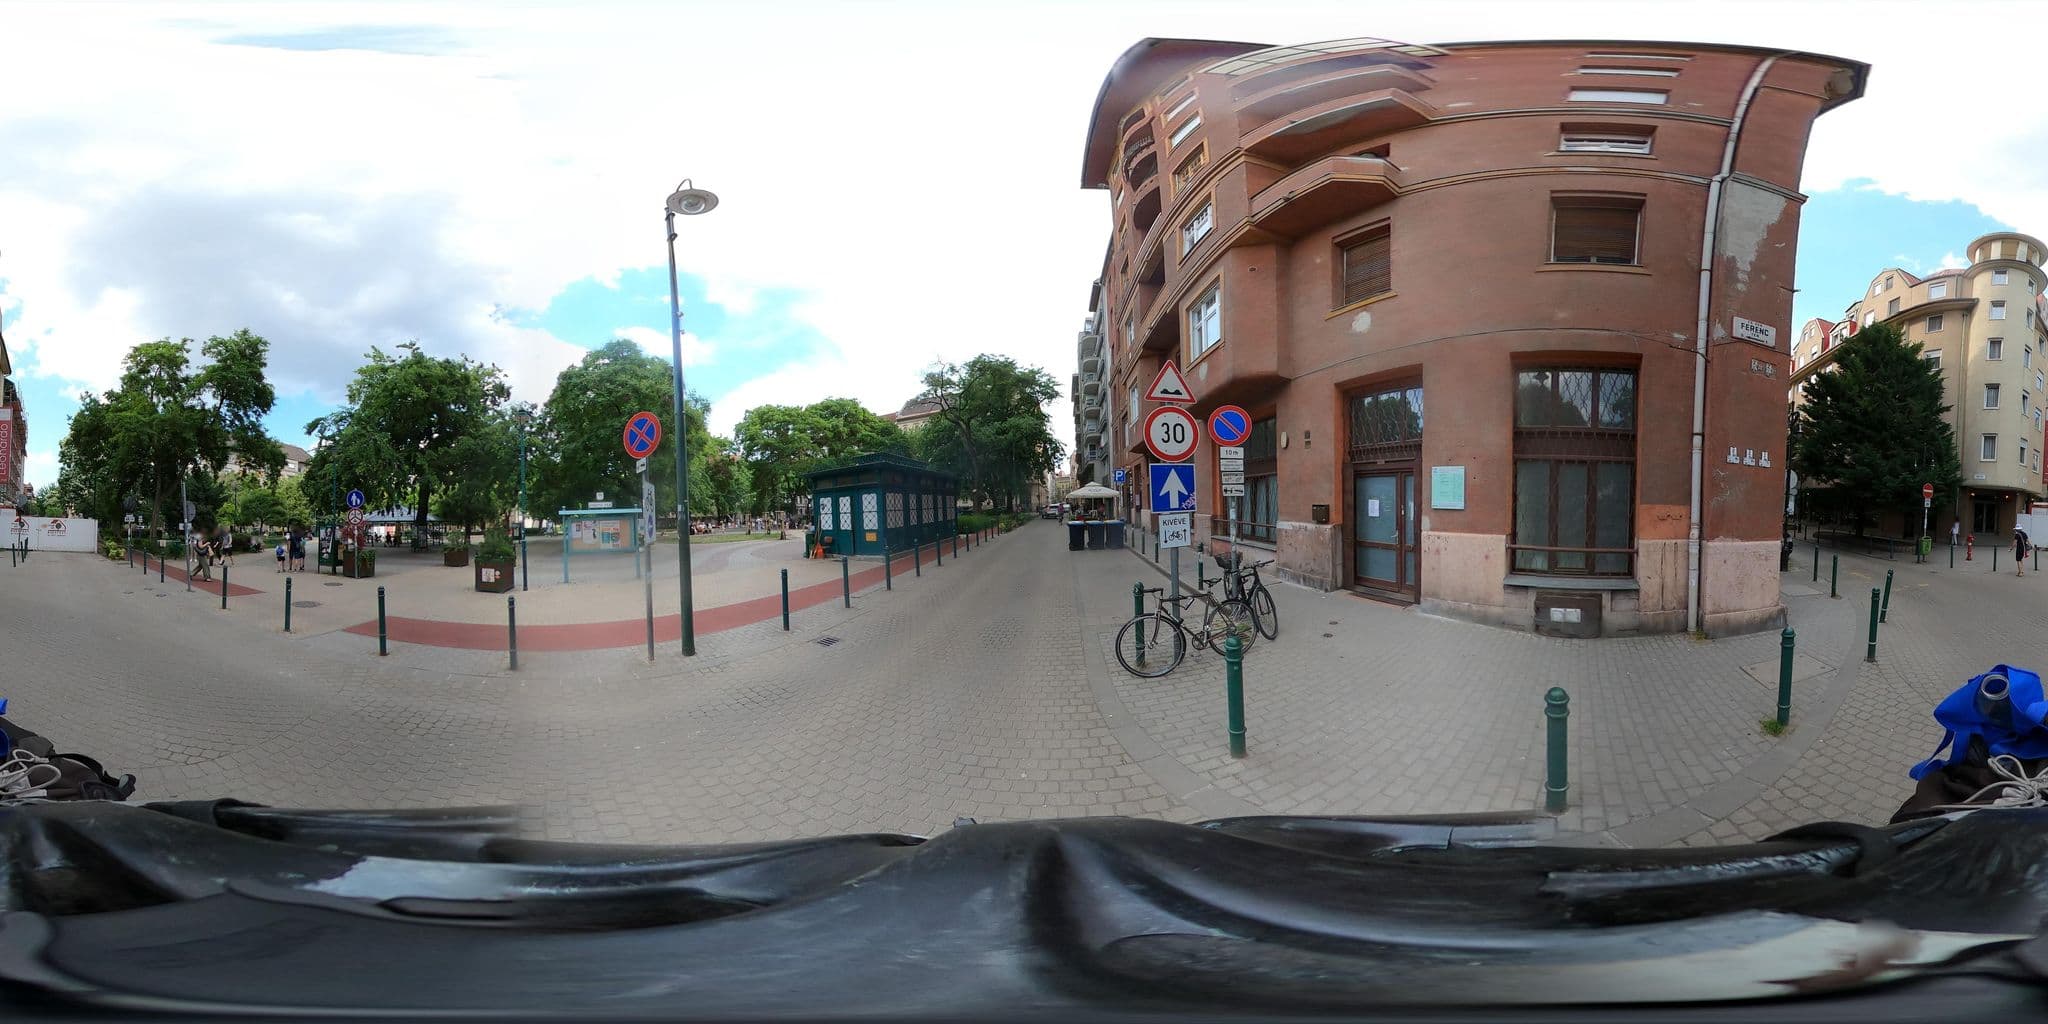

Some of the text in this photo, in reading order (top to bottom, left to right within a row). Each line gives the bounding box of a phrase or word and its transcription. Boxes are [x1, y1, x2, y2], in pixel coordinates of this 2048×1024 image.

[1740, 322, 1769, 337] FERENC
[1161, 422, 1185, 444] 30
[0, 423, 9, 475] Leonardo
[1115, 470, 1124, 481] P
[1162, 517, 1187, 526] KIVÉVE
